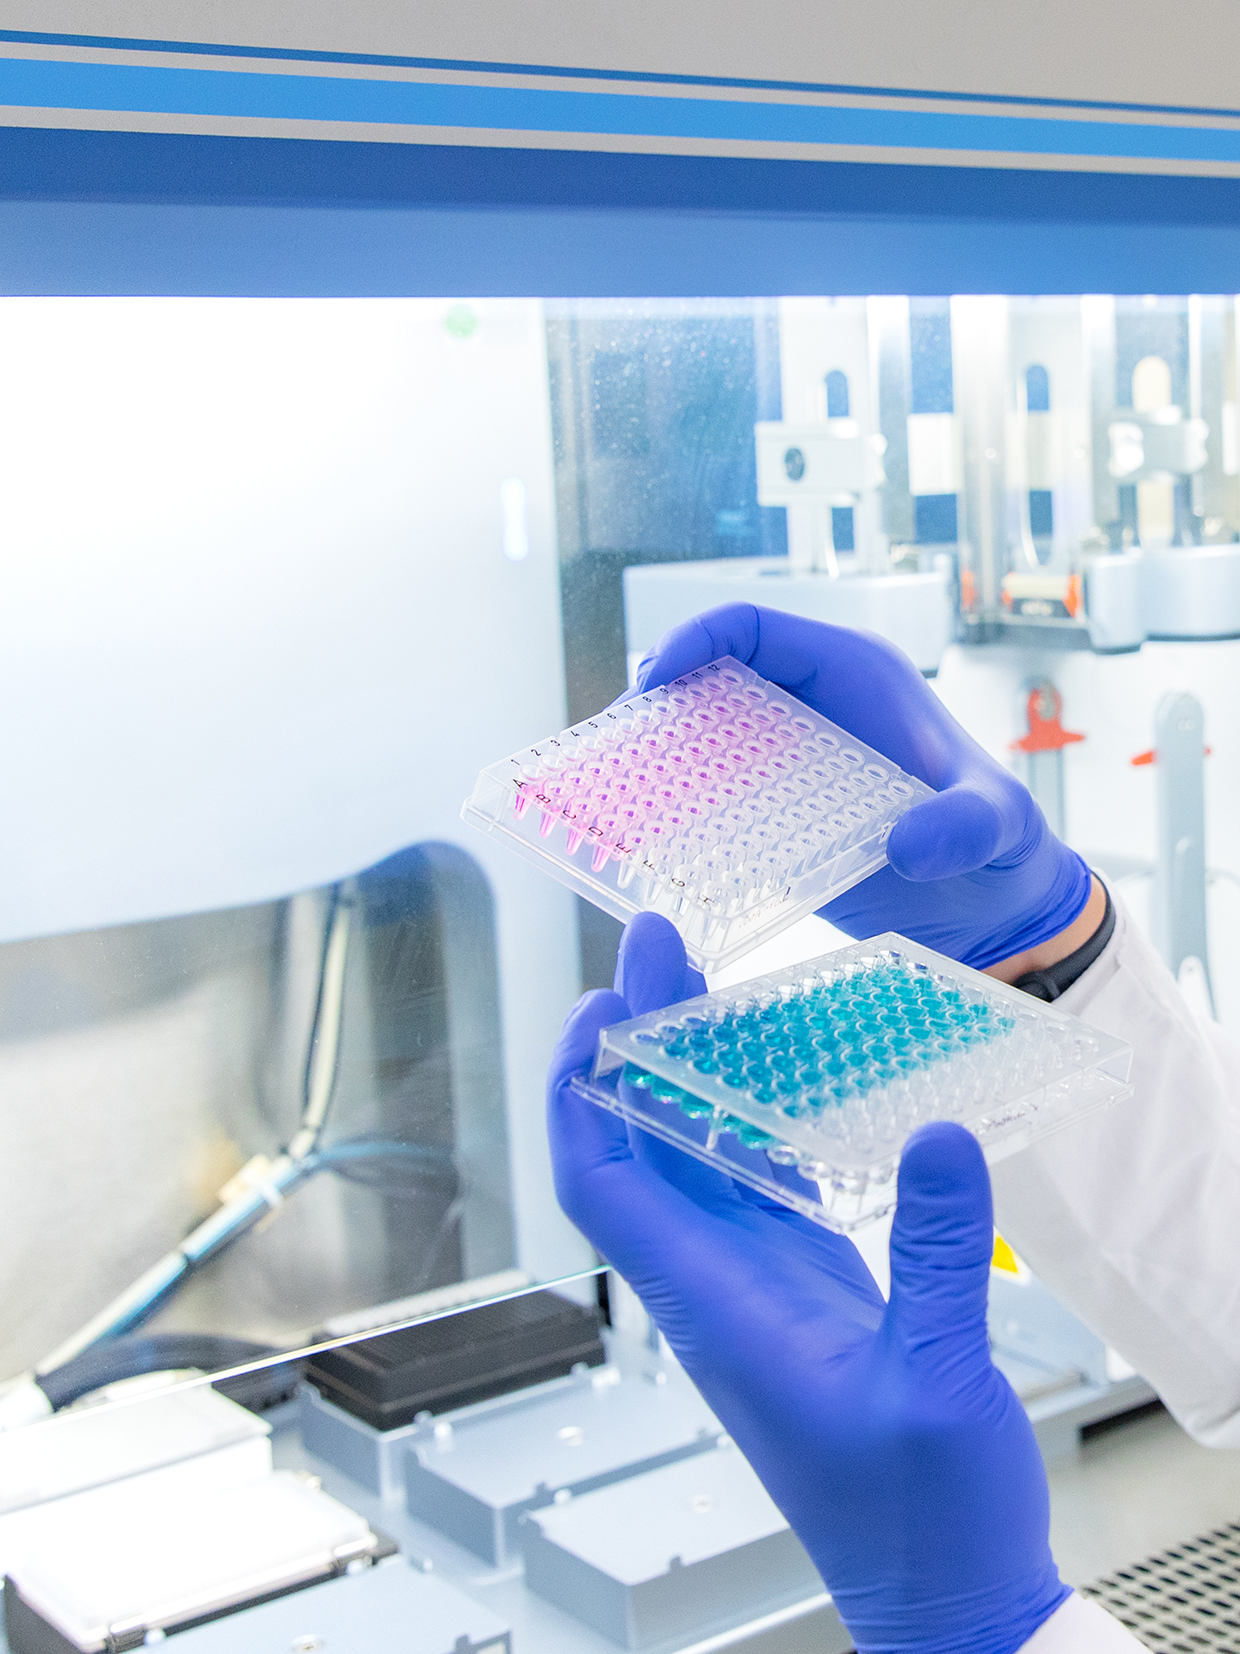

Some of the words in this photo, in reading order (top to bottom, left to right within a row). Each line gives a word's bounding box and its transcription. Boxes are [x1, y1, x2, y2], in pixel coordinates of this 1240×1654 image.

[530, 749, 542, 757] 2
[550, 739, 560, 747] 3
[588, 721, 598, 729] 5
[606, 712, 617, 720] 6
[659, 687, 669, 695] 9
[674, 679, 688, 688] 10
[691, 671, 704, 679] 11
[707, 664, 720, 672] 12
[512, 778, 528, 788] A
[536, 794, 551, 804] B
[562, 810, 576, 819] C
[588, 826, 603, 836] D
[615, 843, 631, 853] E
[643, 859, 655, 870] F
[671, 878, 685, 887] G
[697, 894, 715, 905] H
